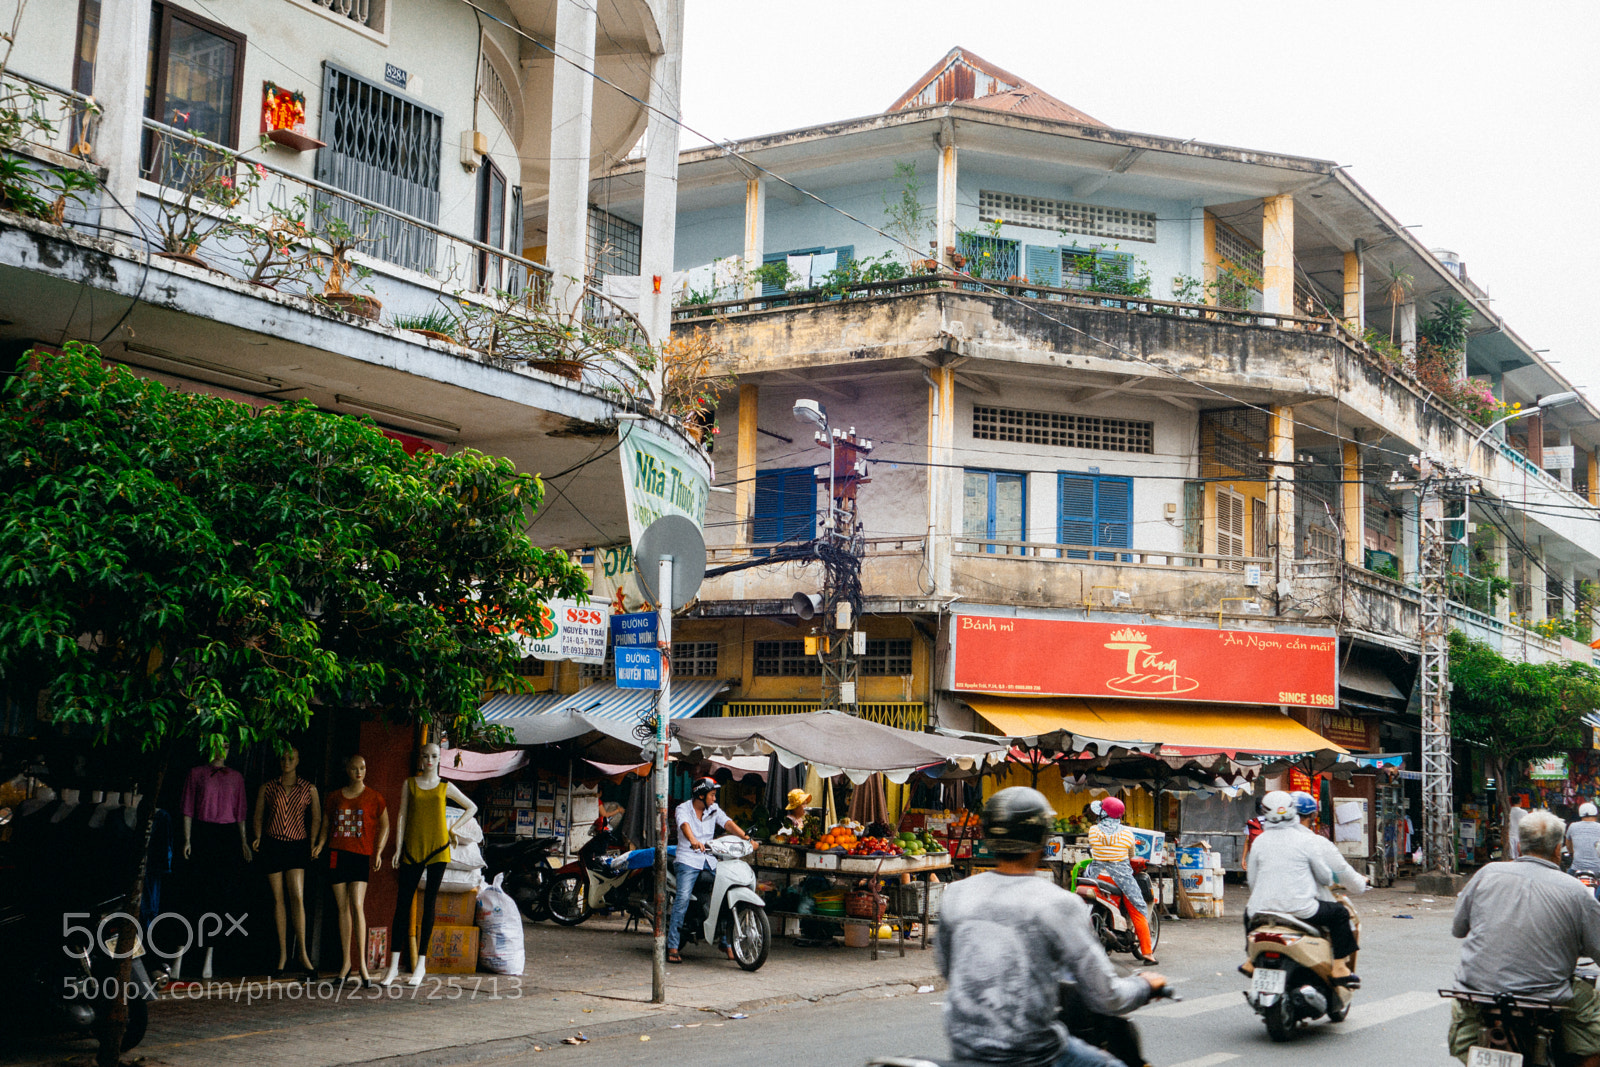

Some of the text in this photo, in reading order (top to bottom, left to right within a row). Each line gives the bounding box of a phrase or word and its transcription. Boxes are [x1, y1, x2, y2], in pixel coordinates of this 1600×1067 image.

[386, 64, 406, 82] 828A
[634, 450, 666, 500] Nhà
[669, 465, 695, 518] Thuốc
[566, 608, 602, 625] 828
[621, 616, 649, 629] ĐƯỜNG
[962, 617, 997, 632] Bánh
[625, 652, 651, 664] ĐƯỜNG
[618, 665, 642, 681] NGUYỄN
[1104, 643, 1177, 690] Tăng
[1279, 691, 1334, 705] SINCE 1968
